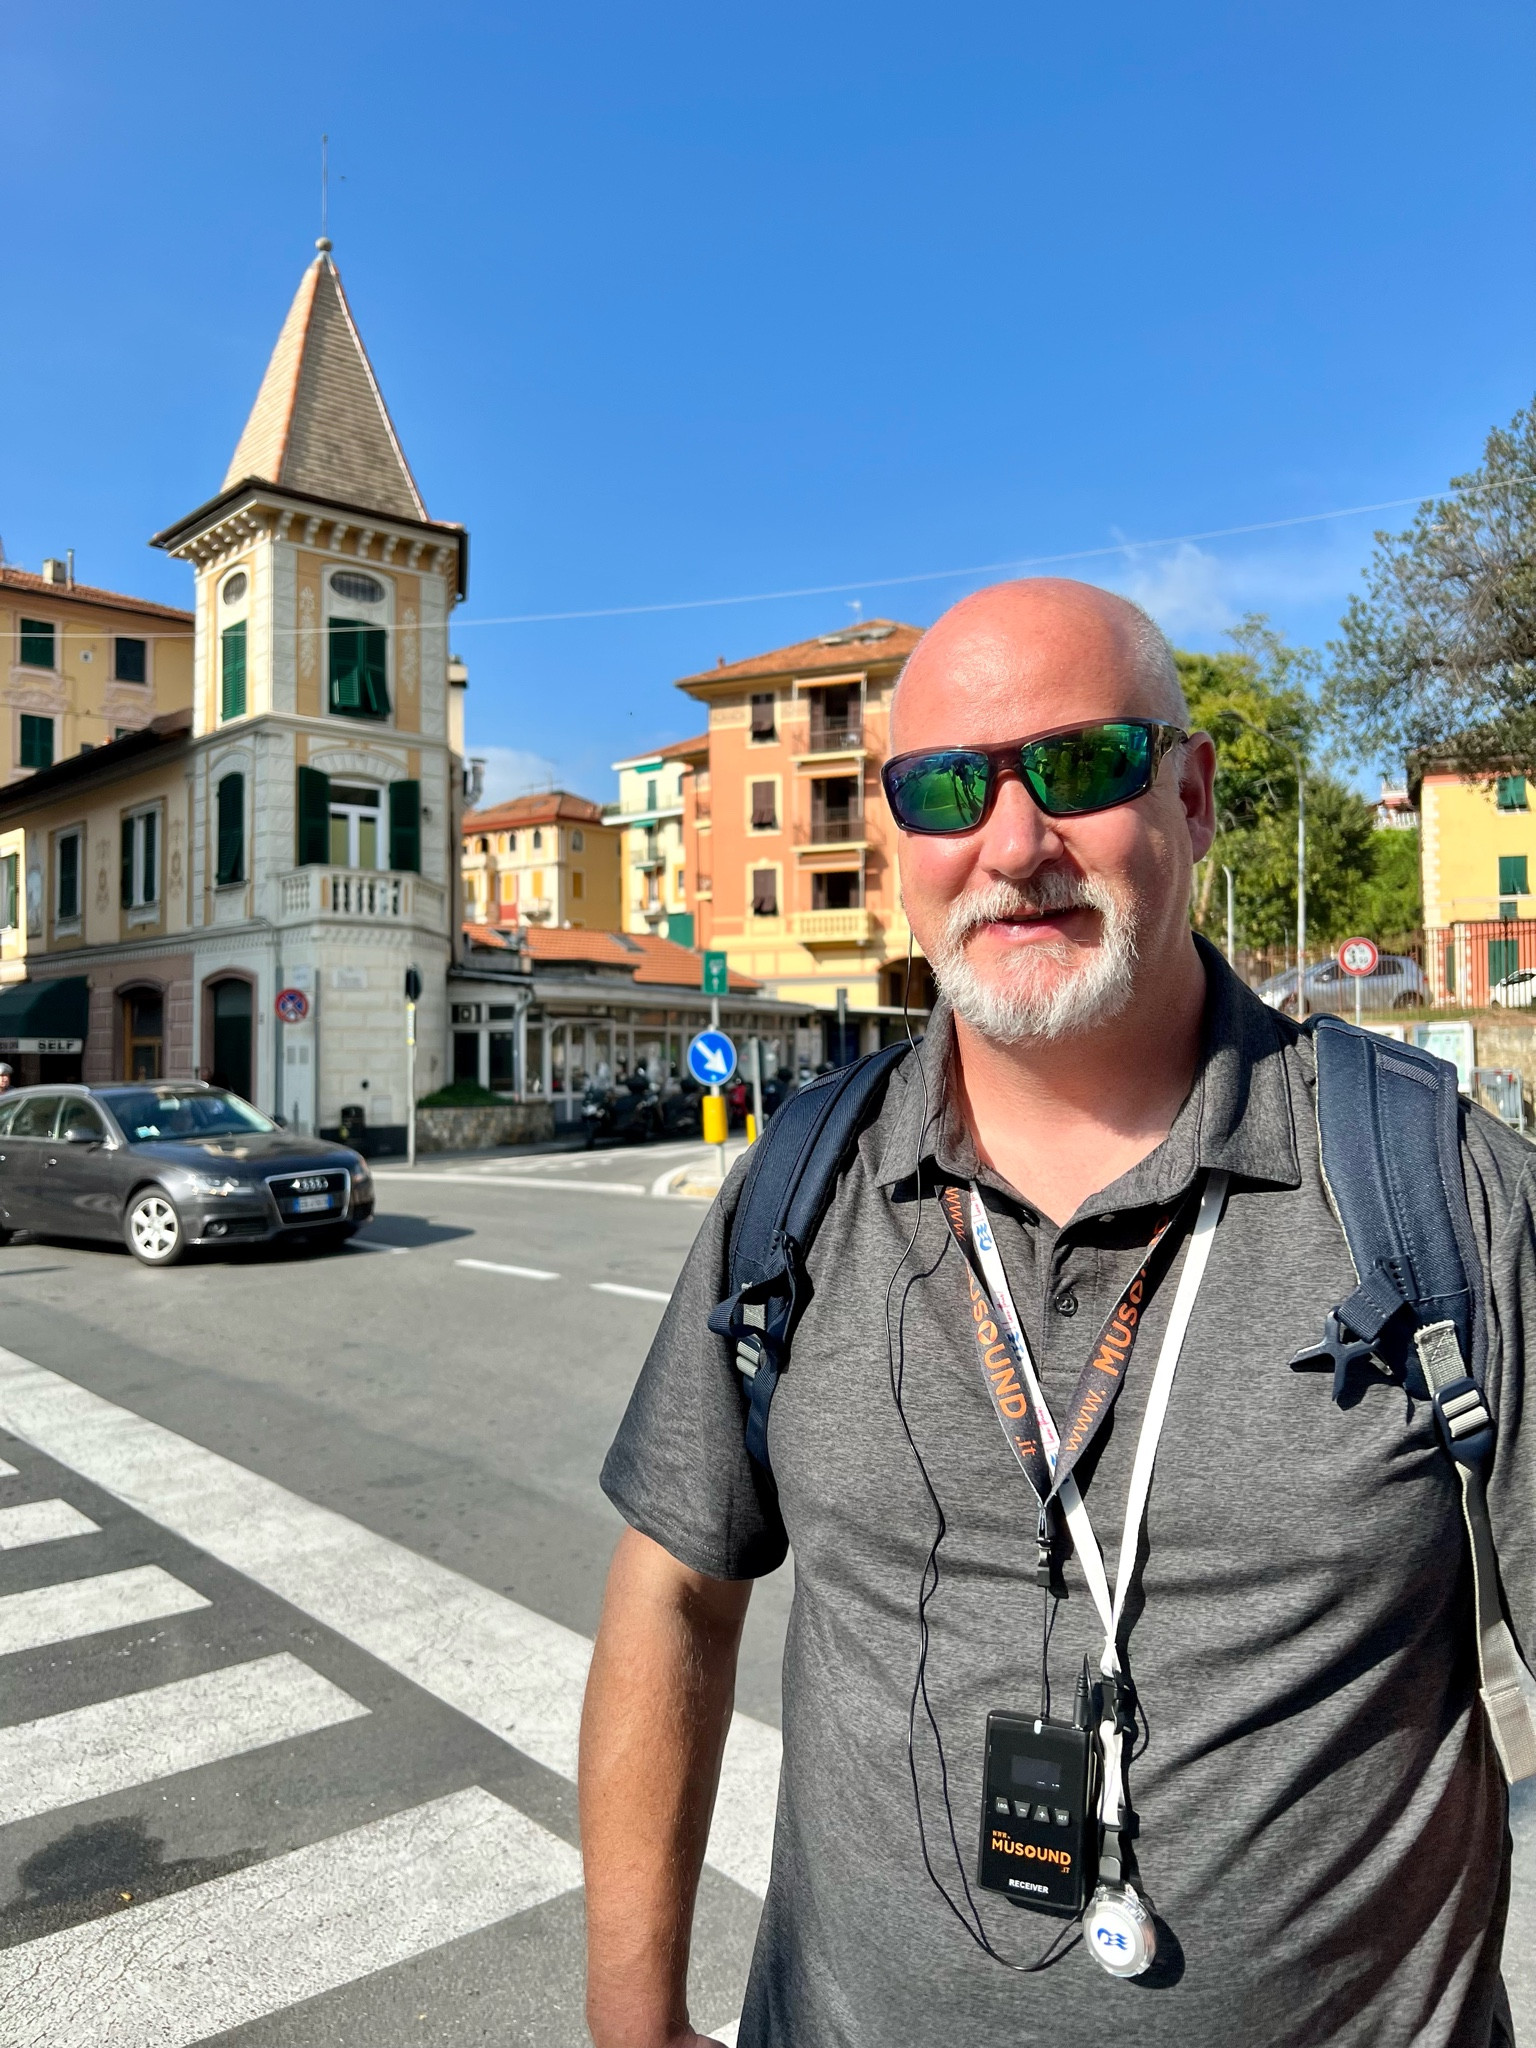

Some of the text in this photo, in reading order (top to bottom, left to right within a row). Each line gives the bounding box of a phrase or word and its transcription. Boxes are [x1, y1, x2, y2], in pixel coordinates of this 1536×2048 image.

[38, 1040, 74, 1052] SELF
[992, 1838, 1071, 1865] MUSOUND
[1008, 1878, 1048, 1893] RECEIVER
